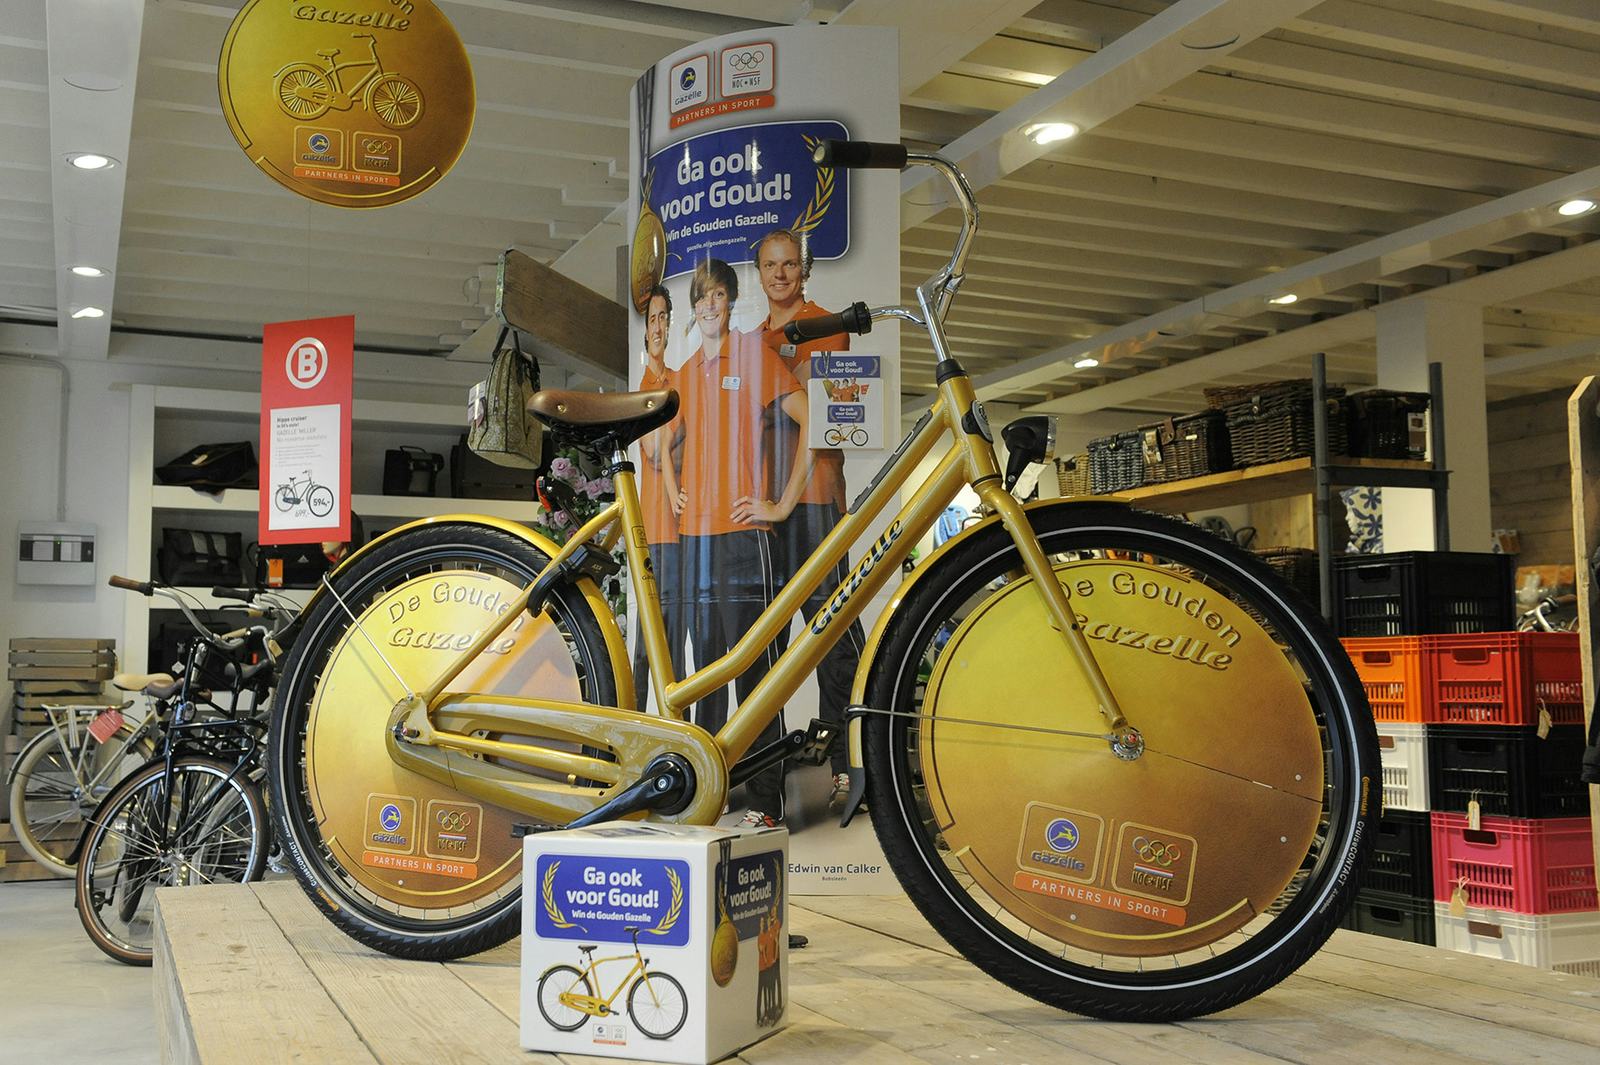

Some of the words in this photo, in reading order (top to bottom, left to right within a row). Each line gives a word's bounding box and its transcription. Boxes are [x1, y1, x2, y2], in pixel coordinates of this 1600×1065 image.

[293, 4, 410, 32] Gazelle
[676, 105, 715, 125] PARTNERS
[718, 102, 728, 112] IN
[731, 98, 761, 110] SPORT
[304, 169, 348, 180] PARTNERS
[352, 174, 361, 182] IN
[364, 175, 389, 184] SPORT
[677, 159, 704, 186] Ga
[709, 144, 763, 174] ook
[660, 190, 705, 223] voor
[709, 173, 792, 208] Goud!
[665, 226, 680, 242] Win
[680, 224, 692, 237] de
[693, 215, 732, 235] Gouden
[734, 211, 779, 228] Gazelle
[845, 366, 863, 374] Goud!
[811, 520, 903, 635] Gazelle
[387, 594, 421, 624] De
[1111, 571, 1242, 649] Gouden
[373, 855, 419, 869] PARTNERS
[422, 860, 433, 870] IN
[436, 863, 465, 875] SPORT
[584, 866, 606, 885] Ga
[609, 867, 642, 886] ook
[738, 867, 748, 885] Ga
[750, 863, 764, 881] ook
[788, 863, 821, 874] Edwin
[824, 865, 843, 874] van
[846, 863, 881, 874] Calker
[566, 890, 606, 906] voor
[608, 888, 659, 909] Goud!
[730, 890, 749, 907] voor
[749, 880, 772, 903] Goud!
[1032, 879, 1102, 903] PARTNERS
[1108, 896, 1121, 908] IN
[1127, 900, 1168, 919] SPORT
[571, 909, 586, 919] Win
[586, 910, 596, 919] de
[596, 910, 624, 921] Gouden
[624, 912, 652, 923] Gazelle
